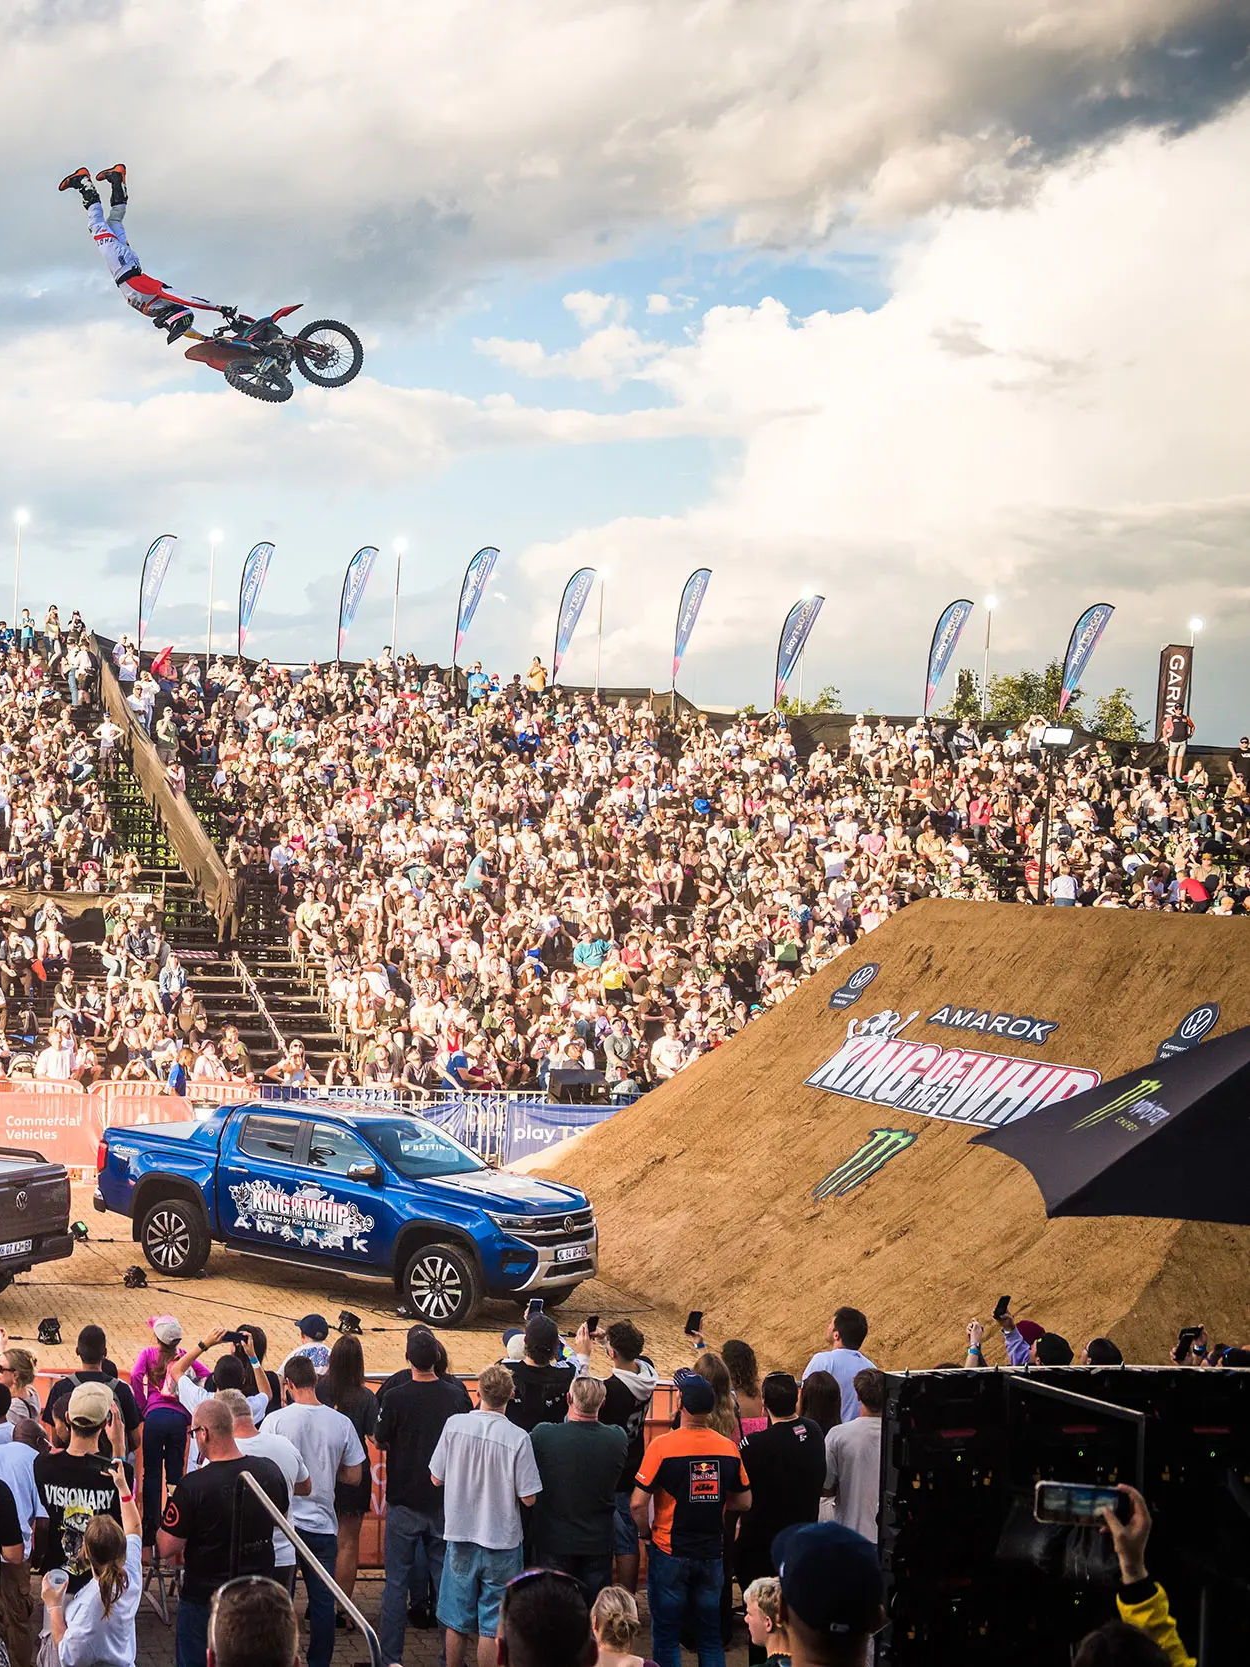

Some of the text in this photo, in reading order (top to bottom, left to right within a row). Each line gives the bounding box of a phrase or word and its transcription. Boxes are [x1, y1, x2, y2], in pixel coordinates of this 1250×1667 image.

[1163, 654, 1185, 718] GARM
[930, 1007, 1054, 1040] AMAROK
[809, 1039, 942, 1104] KING
[921, 1051, 973, 1086] OF
[910, 1081, 954, 1112] THE
[6, 1115, 81, 1127] Commercial
[6, 1128, 58, 1140] Vehicles
[513, 1125, 557, 1144] play
[252, 1191, 290, 1215] KING
[306, 1199, 350, 1225] WHIP
[44, 1484, 115, 1511] VISIONARY
